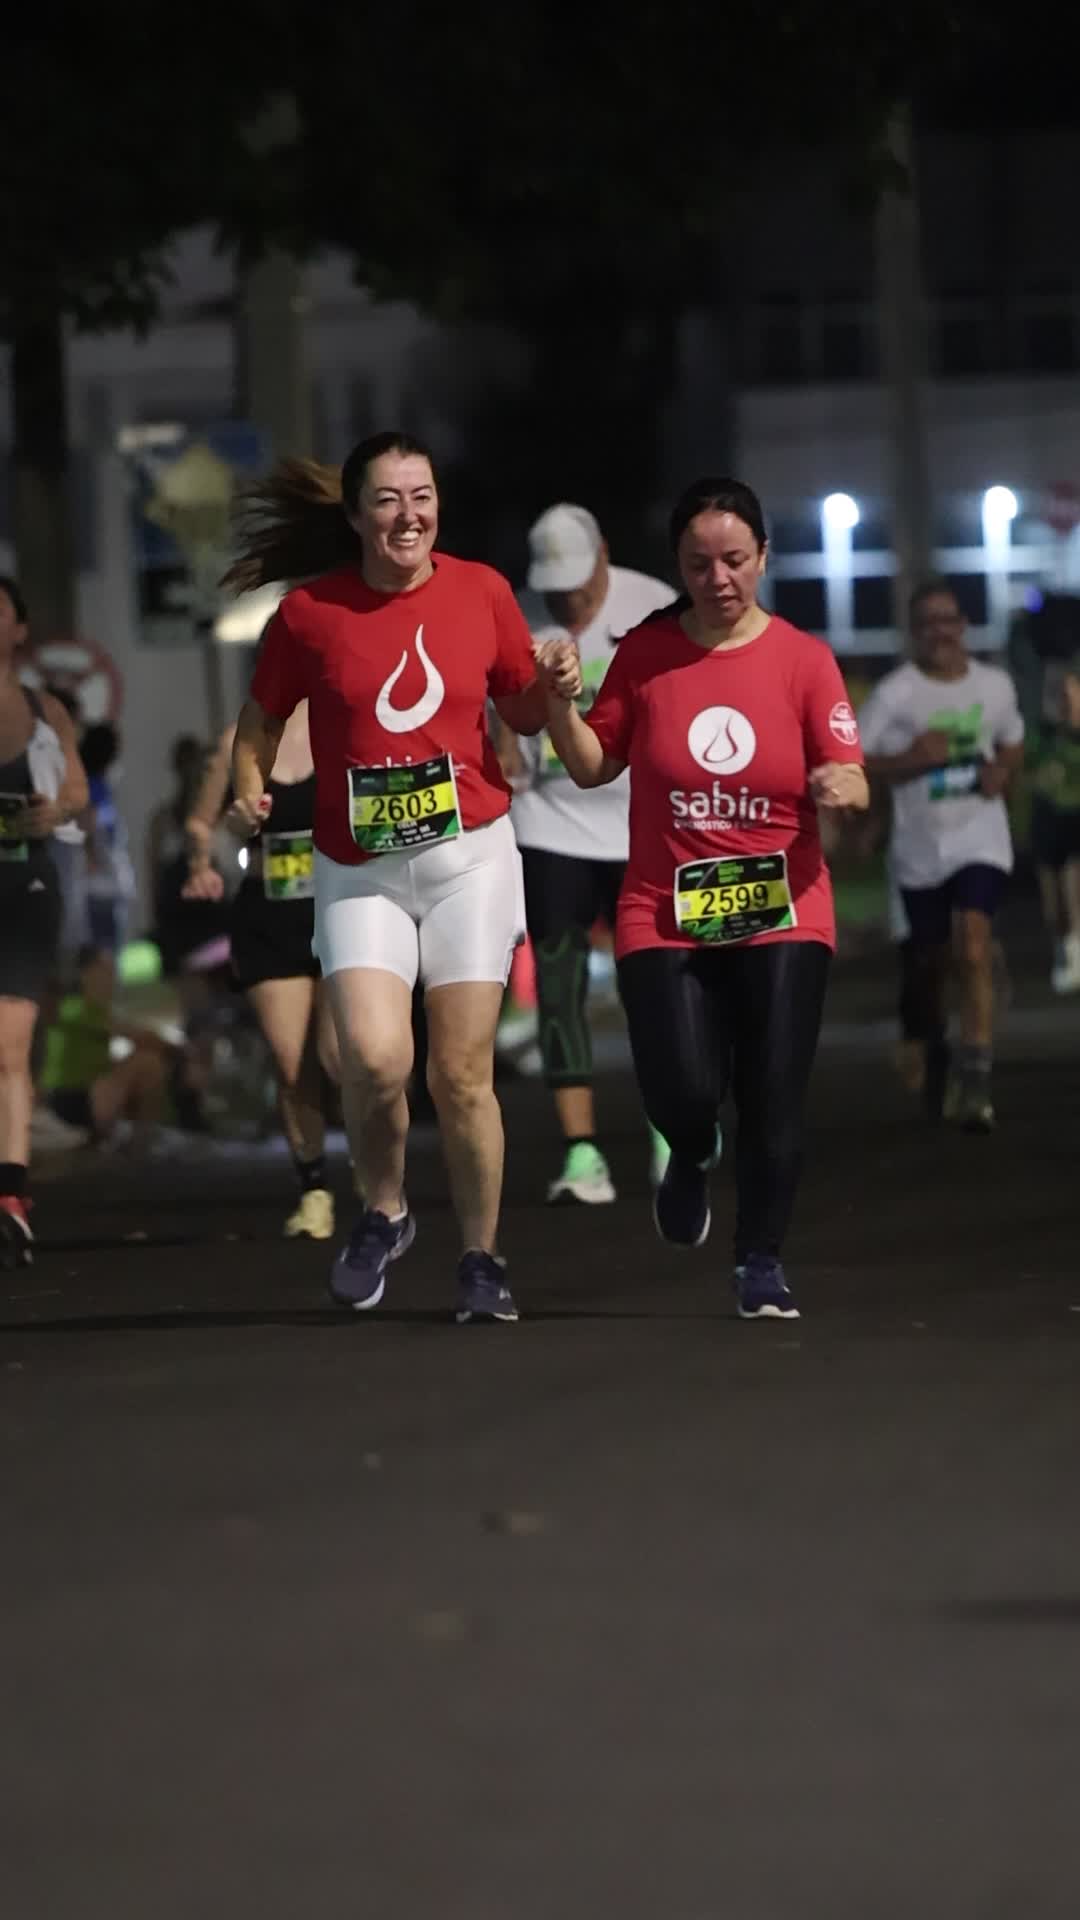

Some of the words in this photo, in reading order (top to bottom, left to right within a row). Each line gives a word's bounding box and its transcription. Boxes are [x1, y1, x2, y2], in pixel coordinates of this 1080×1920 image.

[371, 789, 438, 823] 2603
[669, 780, 771, 820] sabin
[700, 884, 768, 915] 2599
